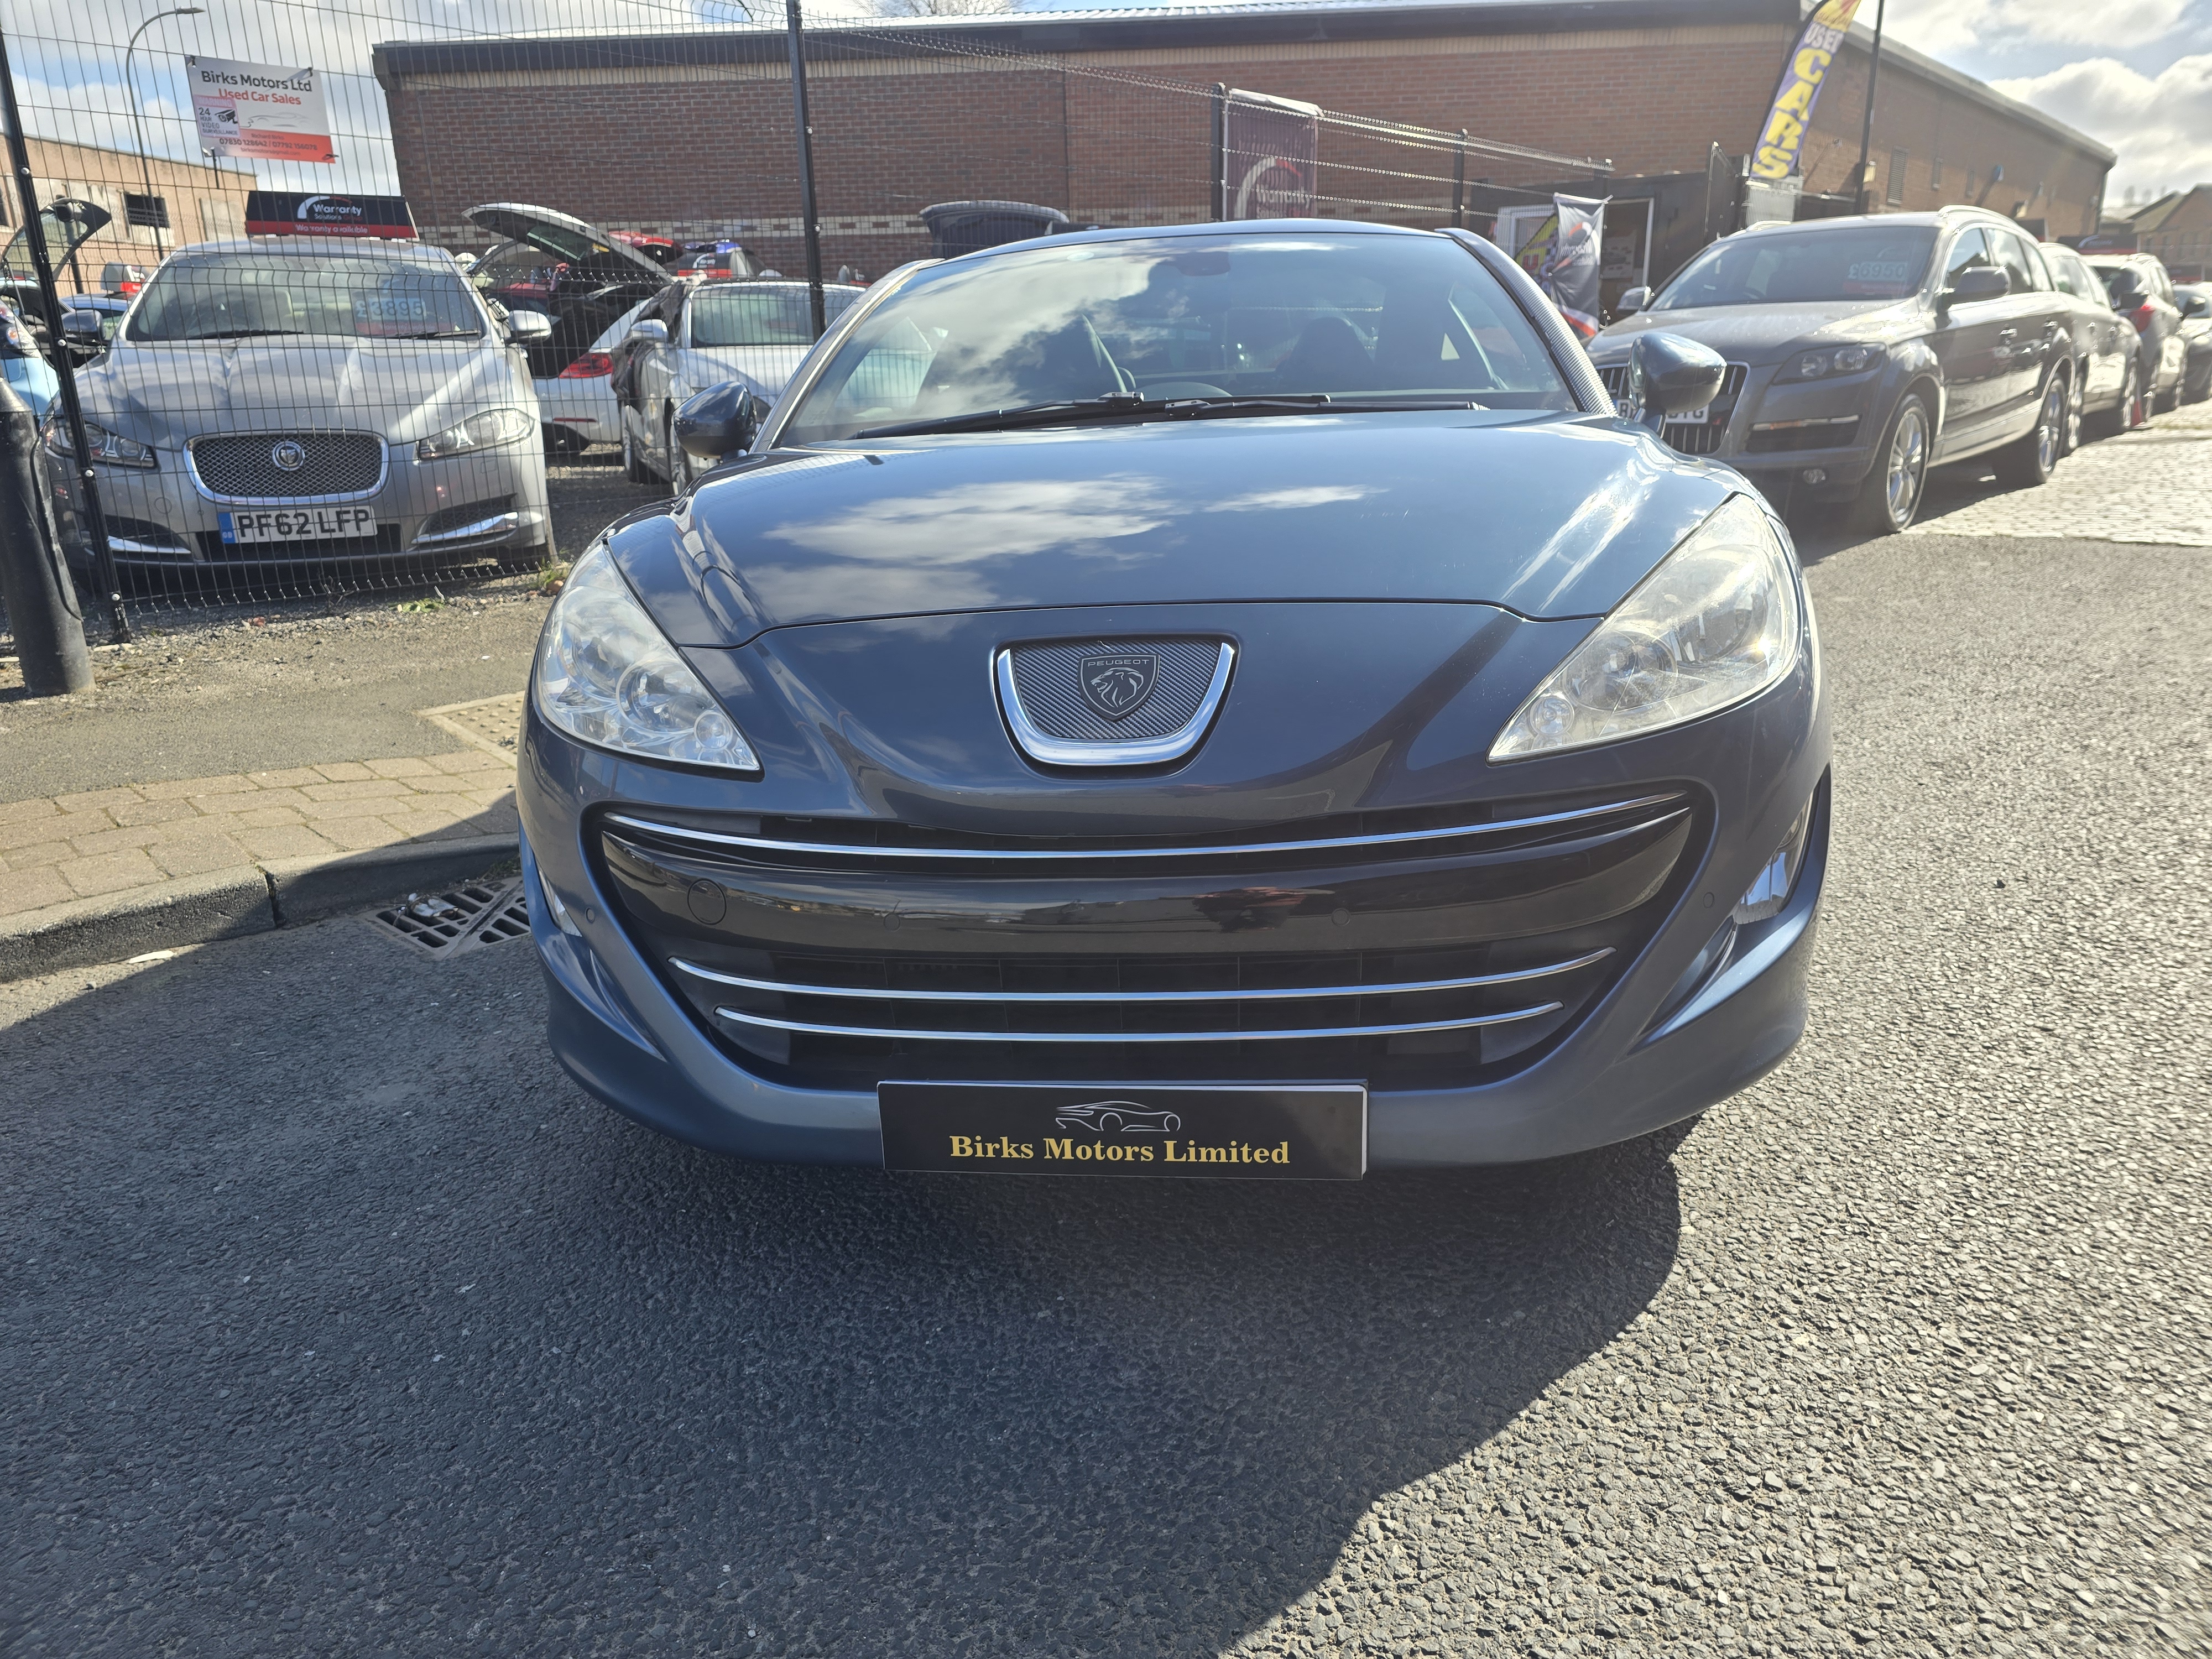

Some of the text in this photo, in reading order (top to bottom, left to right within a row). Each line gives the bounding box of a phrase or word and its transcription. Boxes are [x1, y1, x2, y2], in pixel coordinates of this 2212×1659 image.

[201, 70, 312, 92] Birks Motors Ltd
[218, 88, 301, 105] Used Car Sales
[199, 107, 211, 116] 24
[1752, 48, 1832, 179] CARS
[312, 204, 362, 217] Warranty
[295, 224, 331, 234] Warranty
[237, 509, 370, 538] PF62 LFP
[950, 1135, 1290, 1165] Birks Motors Limited
